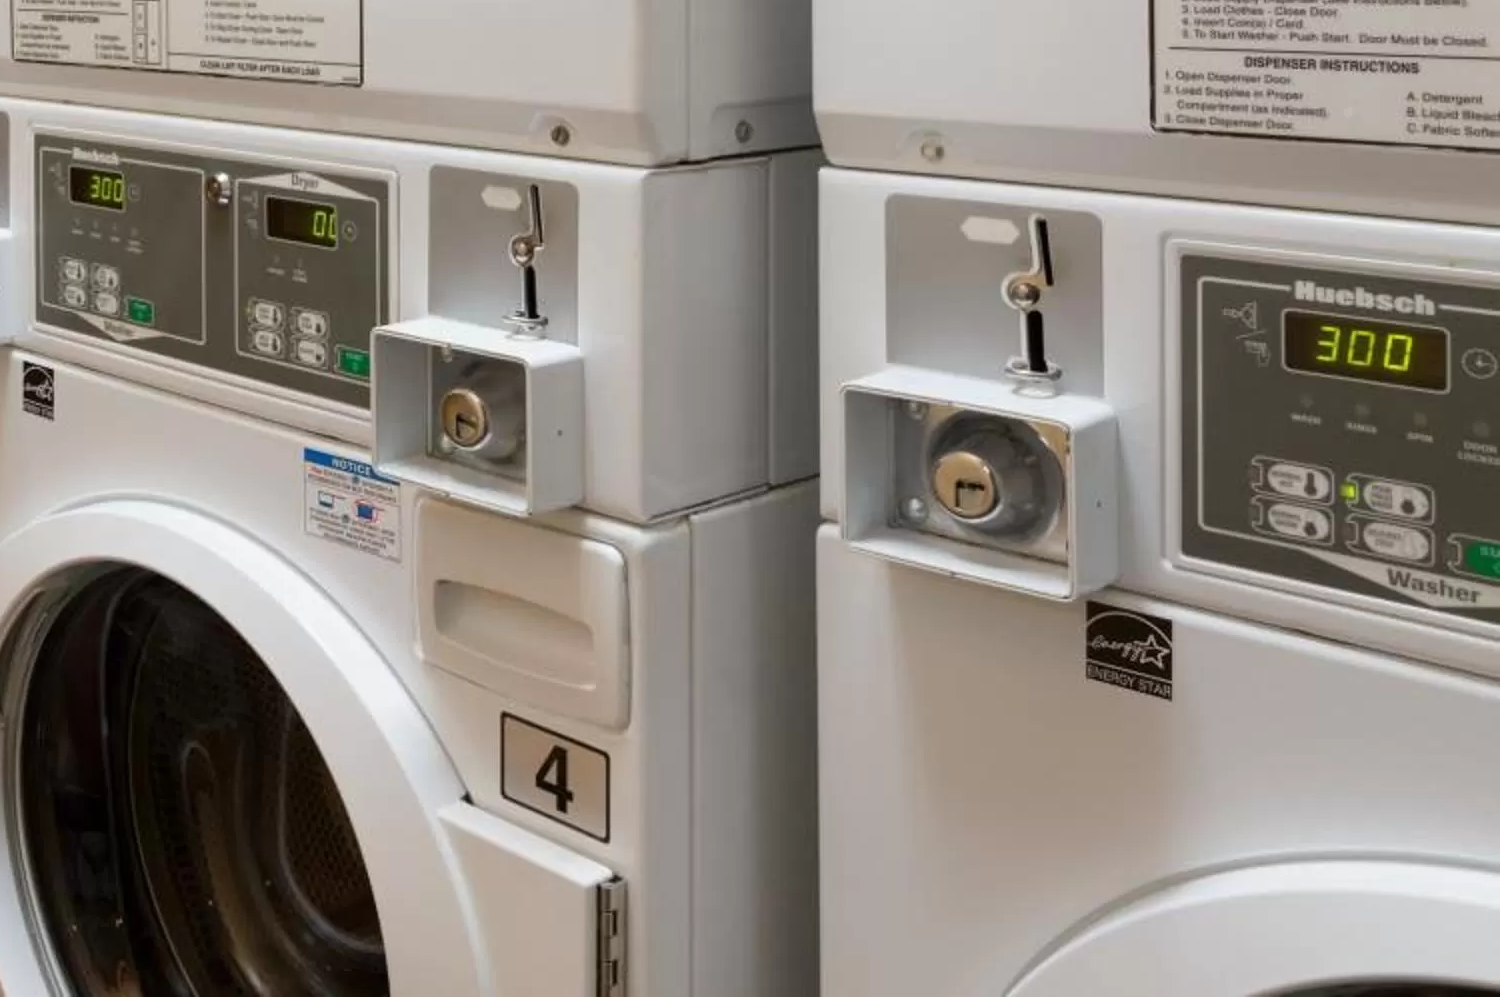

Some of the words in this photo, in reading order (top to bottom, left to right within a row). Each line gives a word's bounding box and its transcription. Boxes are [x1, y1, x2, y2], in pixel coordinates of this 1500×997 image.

[1193, 5, 1220, 14] Load
[1223, 6, 1264, 16] Clothes
[1274, 6, 1306, 16] Close
[1194, 29, 1206, 38] To
[1210, 30, 1234, 39] Start
[1289, 32, 1318, 41] Push
[1359, 33, 1387, 43] Door
[1391, 34, 1420, 45] Must
[1424, 35, 1438, 45] be
[1244, 56, 1316, 70] DISPENSER
[1320, 58, 1420, 74] INSTRUCTIONS
[1175, 70, 1204, 82] Open
[1176, 85, 1202, 95] Load
[1266, 89, 1303, 100] Proper
[1421, 92, 1484, 105] Detergent
[91, 175, 124, 202] 300
[292, 174, 319, 190] Dryer
[1294, 280, 1436, 315] Huebsch
[1315, 325, 1413, 372] 300
[331, 458, 371, 476] NOTICE
[1387, 568, 1481, 603] Washer
[1087, 665, 1136, 688] ENERGY
[1138, 679, 1171, 698] STAR
[536, 745, 574, 813] 4
